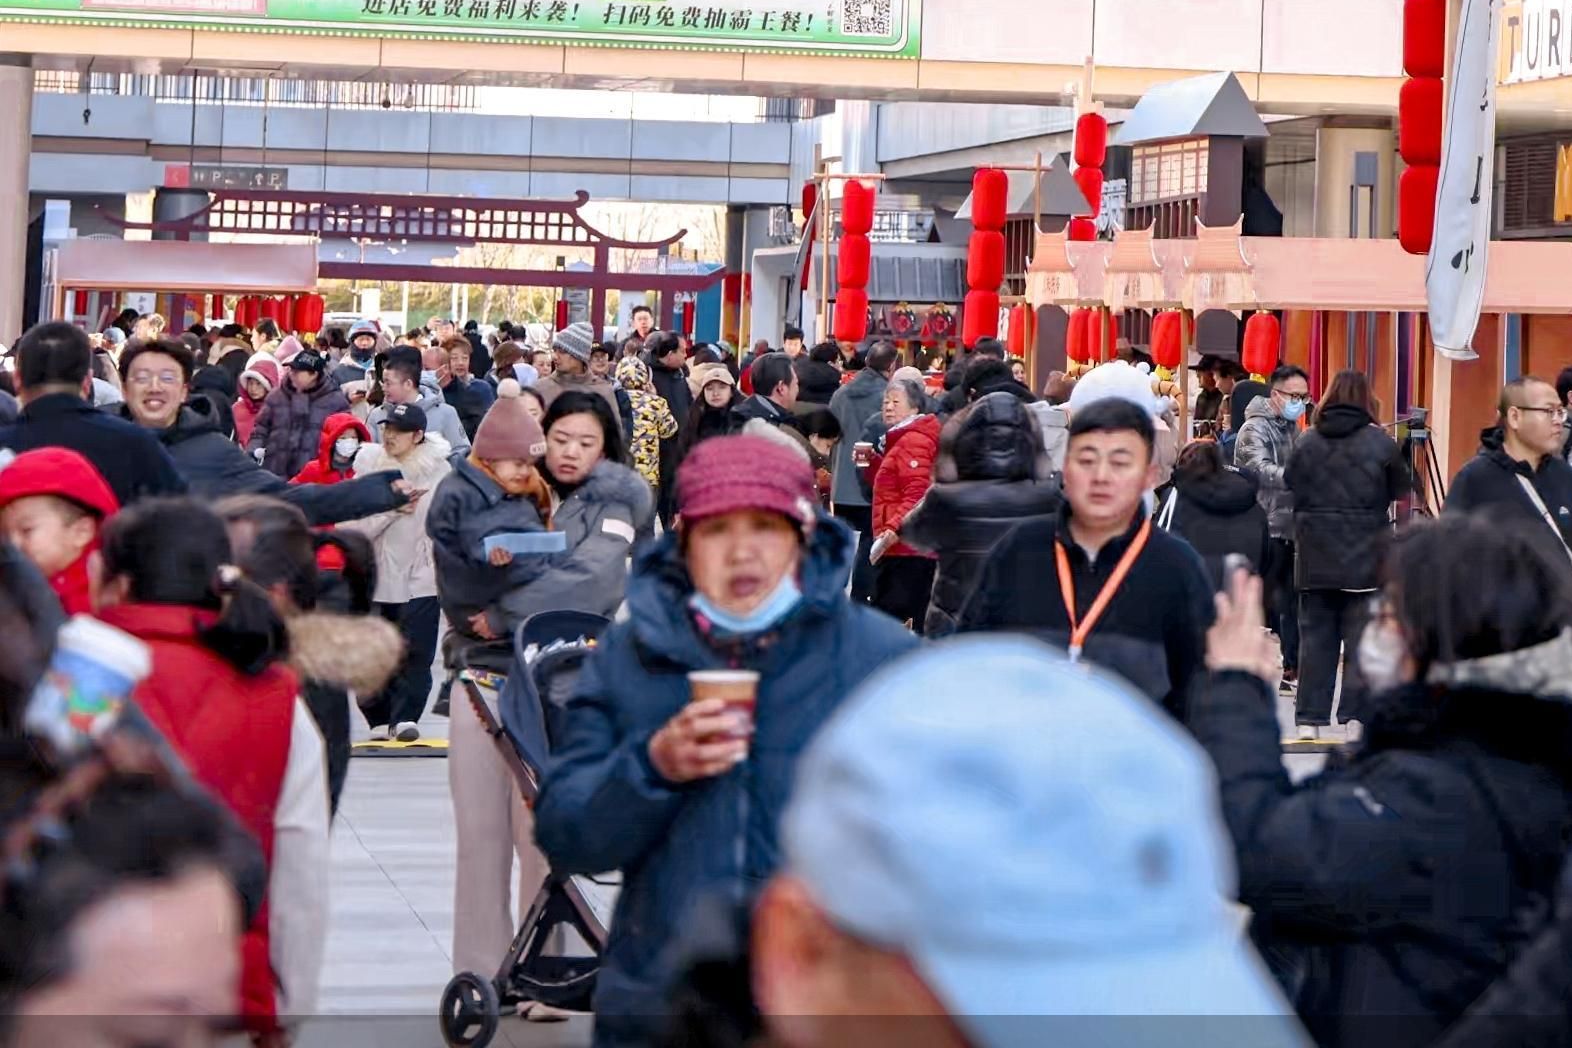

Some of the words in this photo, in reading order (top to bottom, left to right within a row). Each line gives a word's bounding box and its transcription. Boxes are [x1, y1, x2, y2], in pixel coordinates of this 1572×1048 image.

[603, 3, 814, 33] 扫码免费抽霸王餐！
